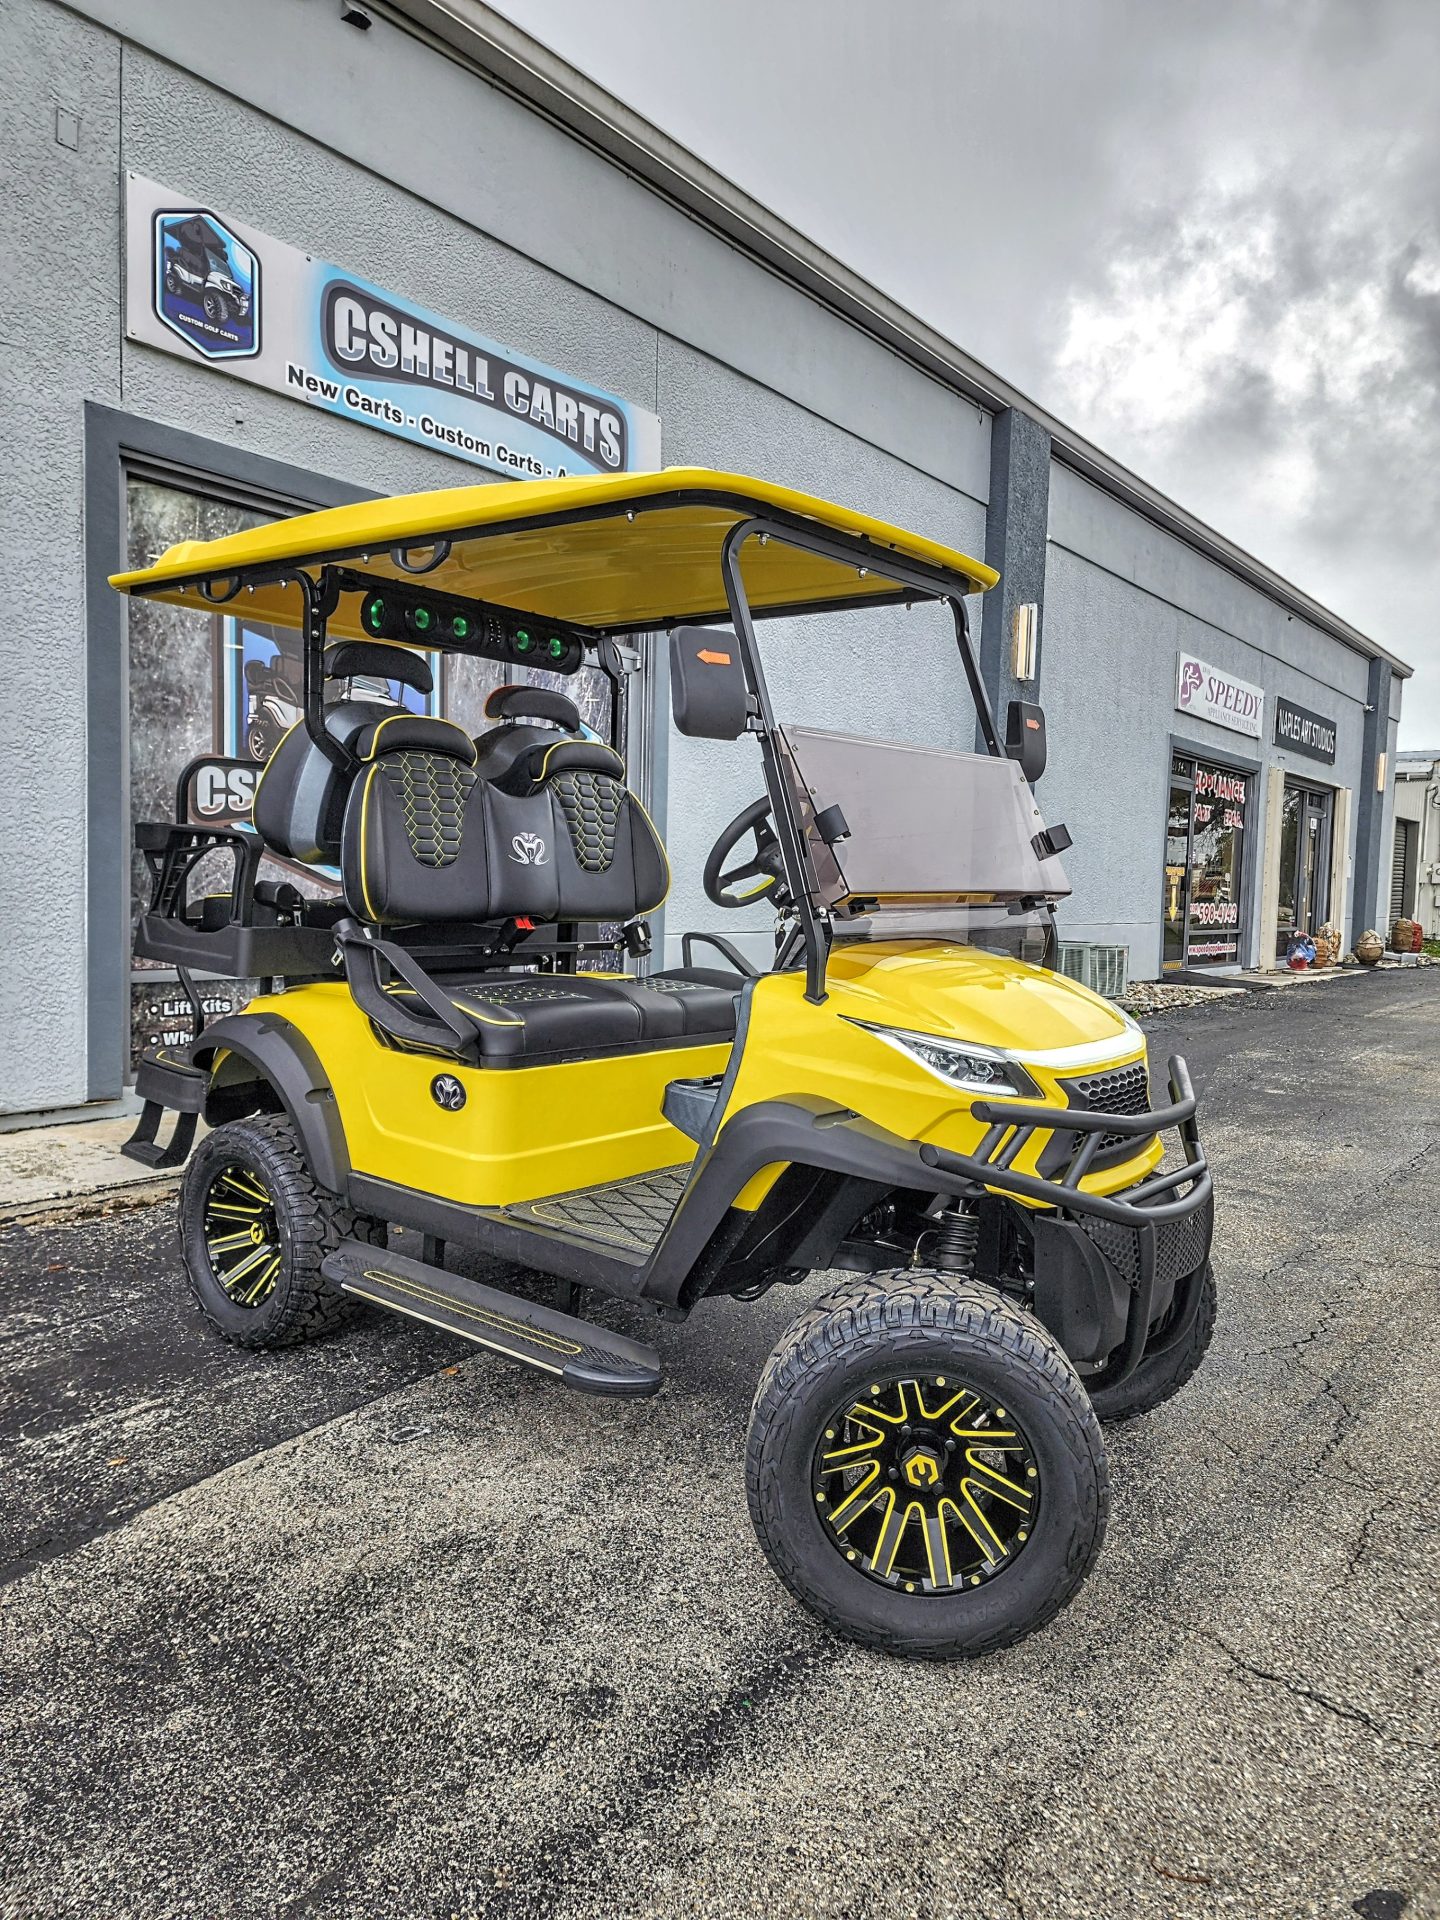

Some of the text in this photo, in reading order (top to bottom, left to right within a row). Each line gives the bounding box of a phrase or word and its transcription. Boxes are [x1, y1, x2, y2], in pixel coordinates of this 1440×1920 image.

[178, 313, 239, 342] CUSTOM GOLF CARTS
[334, 296, 621, 468] CSHELL CARTS
[287, 363, 339, 400] New
[345, 387, 403, 424] Carts
[420, 416, 491, 458] Custom
[496, 445, 542, 476] Carts
[1205, 676, 1263, 720] SPEEDY
[1278, 708, 1335, 754] NAPLES ART STUDIOS
[196, 765, 264, 815] CS
[1195, 769, 1246, 805] APPLIANCE
[1194, 803, 1215, 822] PART
[163, 999, 232, 1016] Lift Kits
